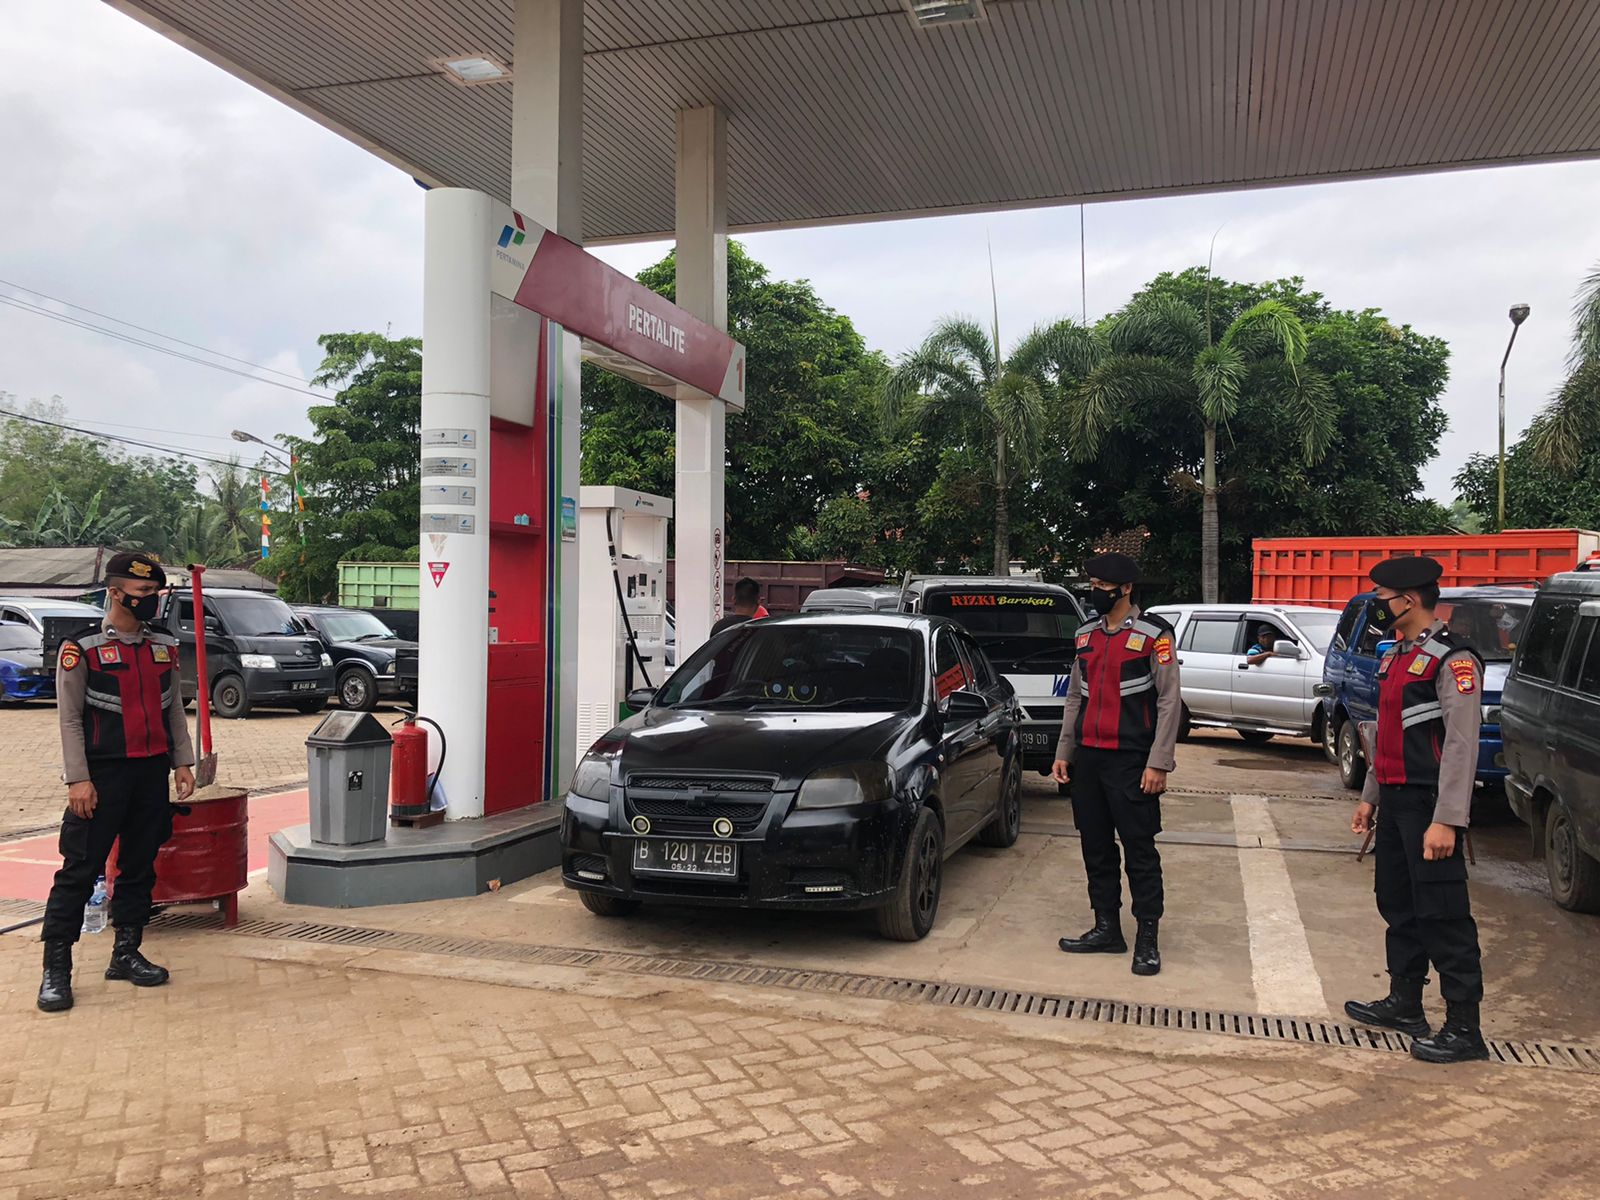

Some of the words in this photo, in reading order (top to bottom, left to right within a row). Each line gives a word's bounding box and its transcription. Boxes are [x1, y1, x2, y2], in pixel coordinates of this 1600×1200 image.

[495, 248, 526, 271] PERTAMINA
[628, 303, 685, 354] PERTALITE
[736, 358, 744, 393] 1
[950, 593, 997, 606] RIZKI
[997, 595, 1056, 607] Barokah
[640, 840, 649, 859] B
[663, 841, 696, 862] 1201
[704, 843, 732, 864] ZEB
